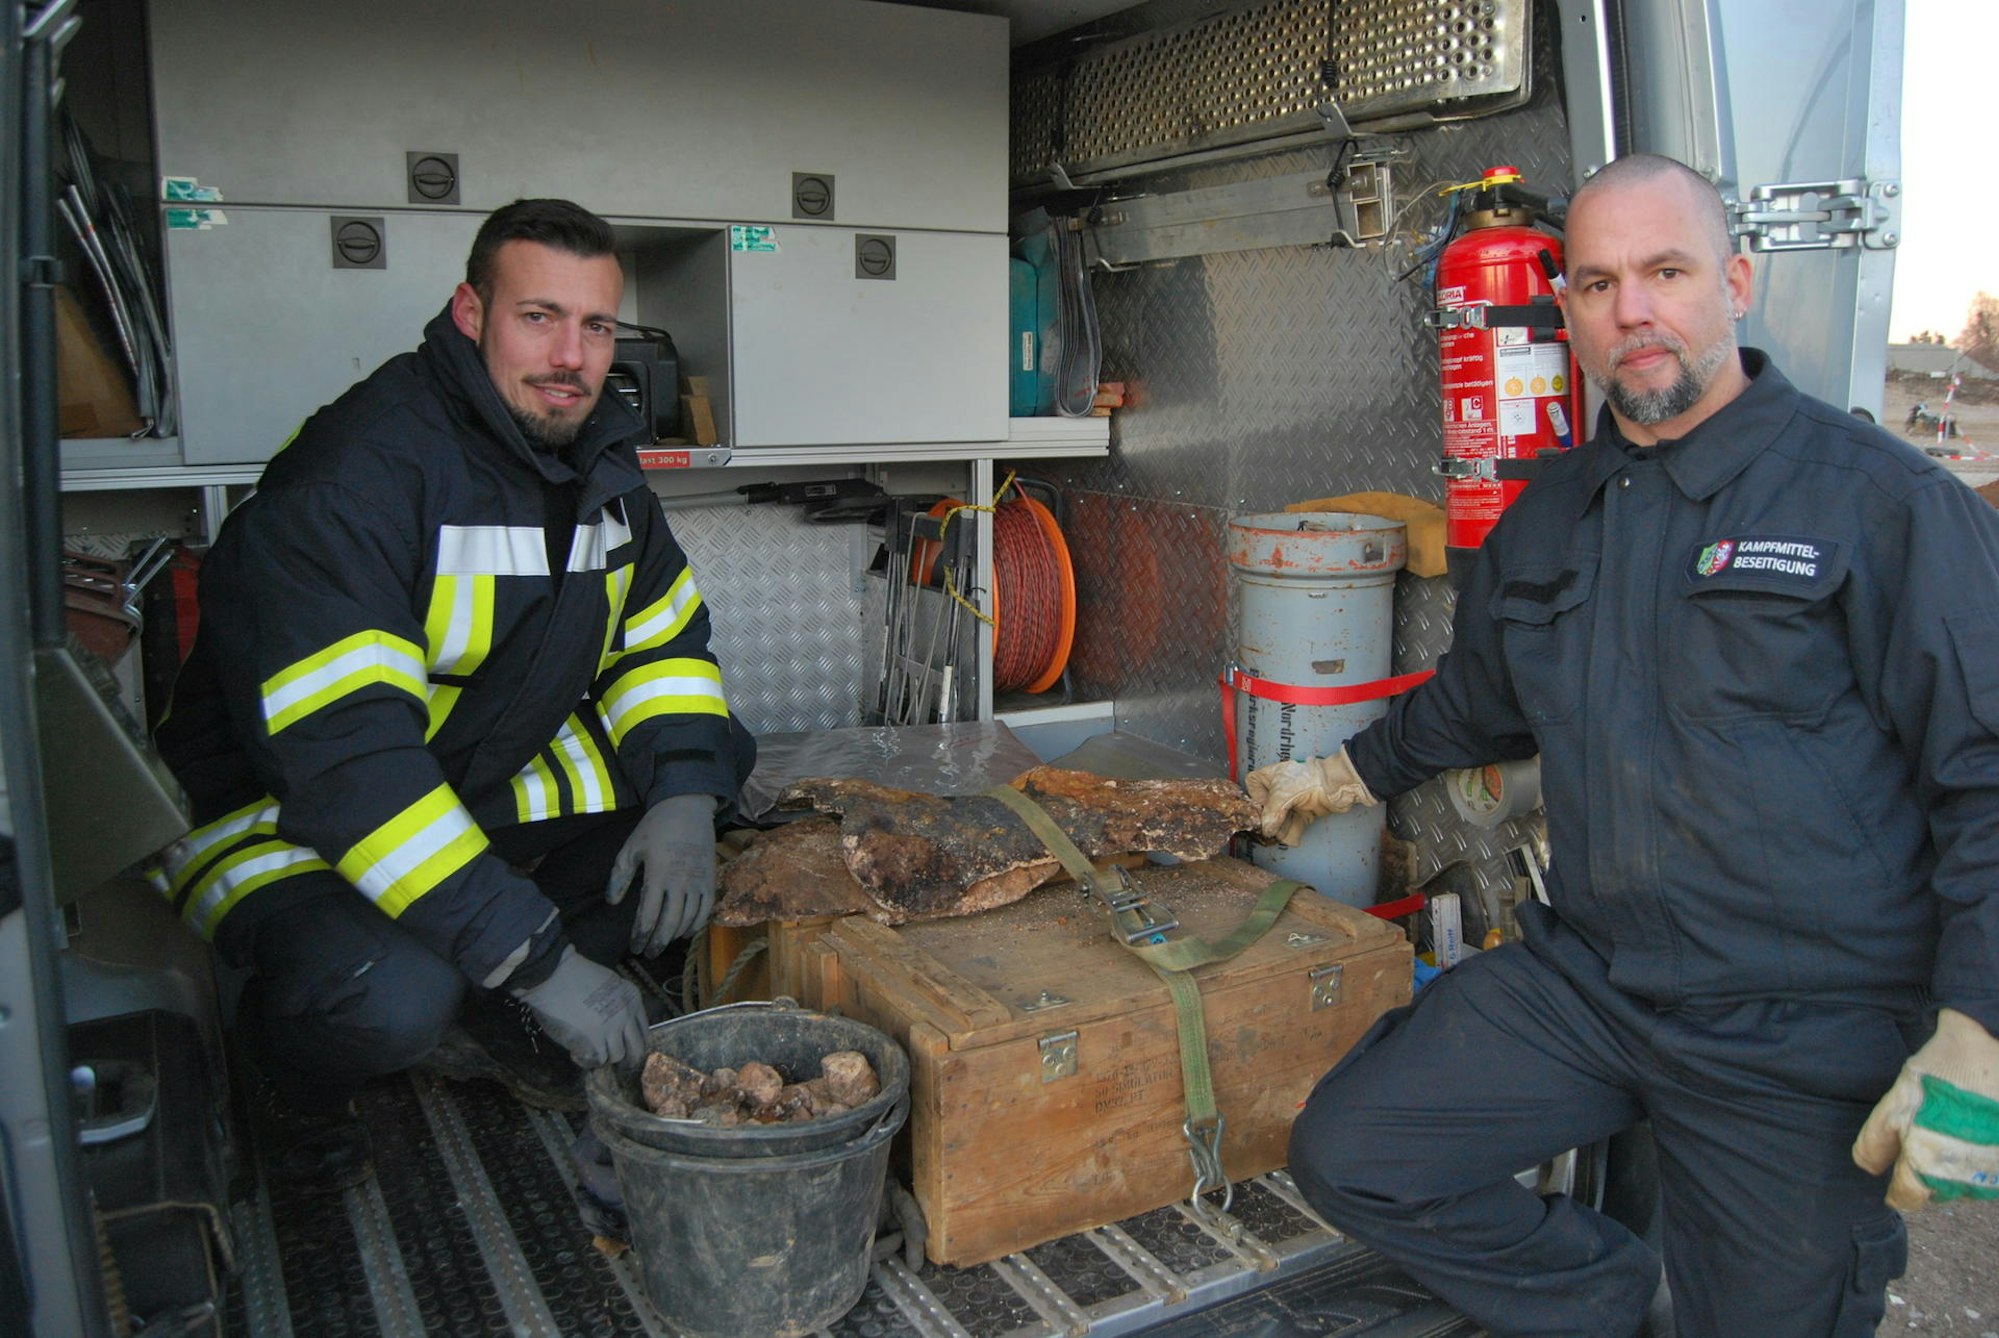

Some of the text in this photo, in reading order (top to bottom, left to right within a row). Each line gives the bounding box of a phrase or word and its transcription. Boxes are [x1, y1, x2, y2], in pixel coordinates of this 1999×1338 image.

[1438, 289, 1462, 302] LORIA
[657, 455, 675, 464] 300
[676, 455, 688, 465] kg
[1738, 541, 1820, 559] KAMPFMITTEL-
[1733, 556, 1817, 577] BESEITIGUNG
[1280, 702, 1296, 762] Nordrhe
